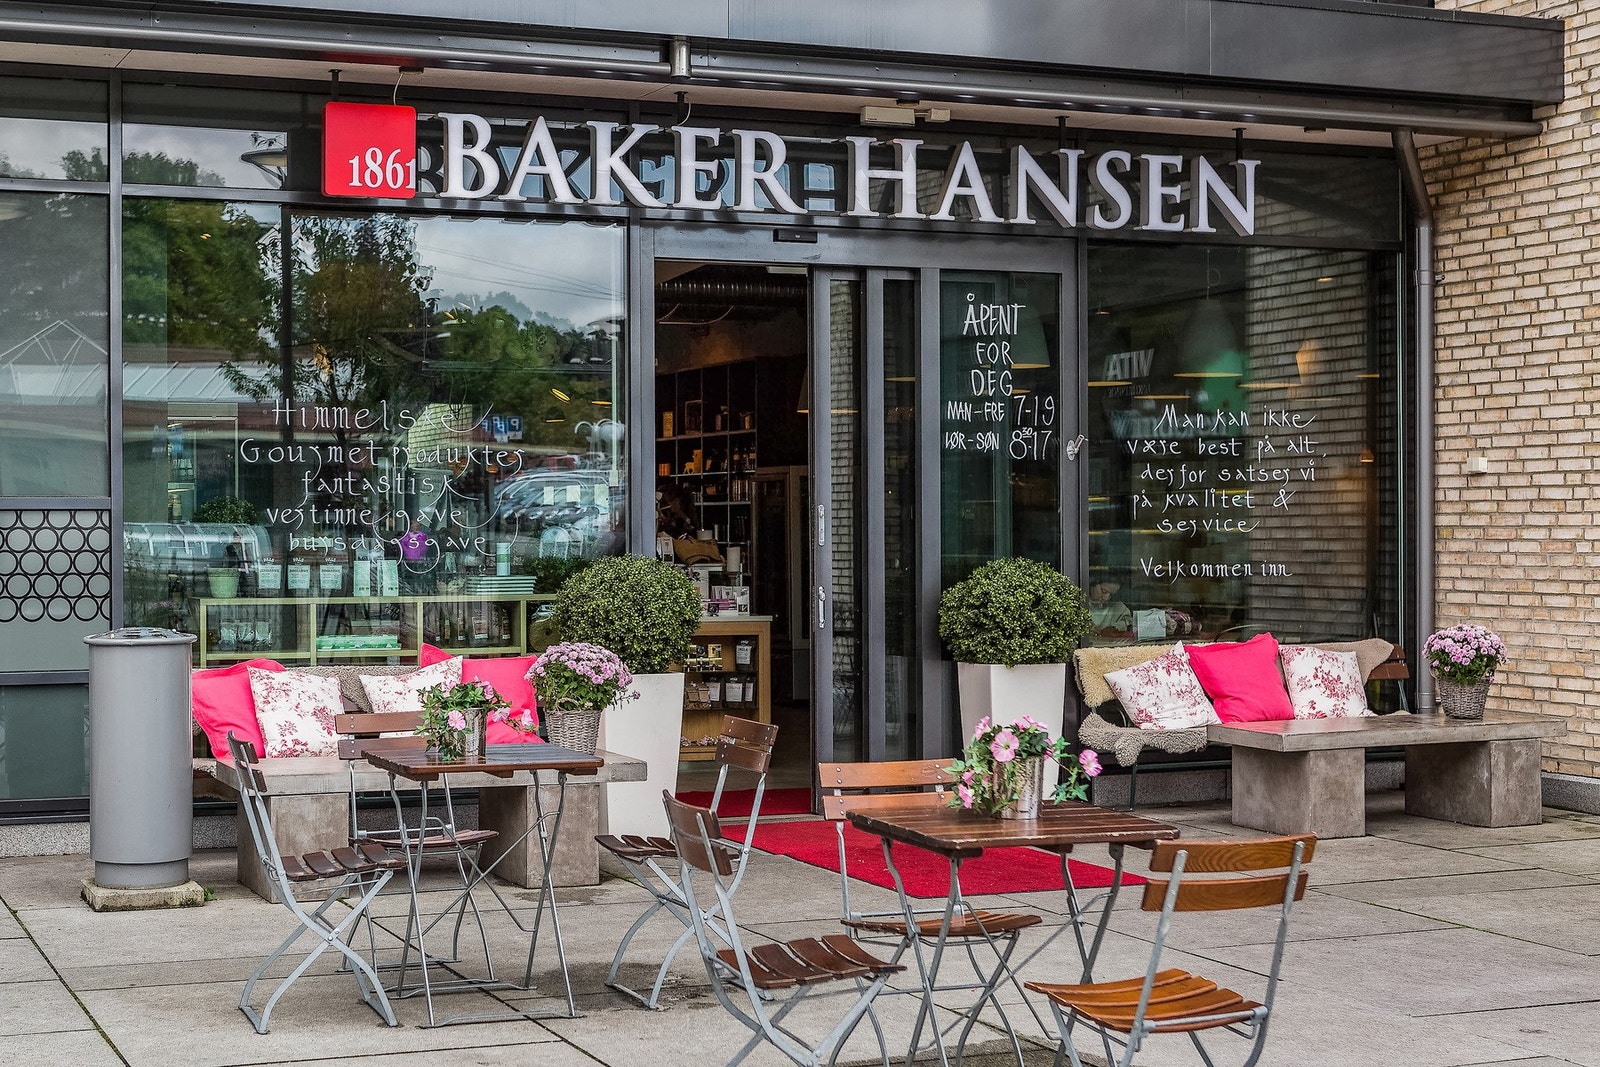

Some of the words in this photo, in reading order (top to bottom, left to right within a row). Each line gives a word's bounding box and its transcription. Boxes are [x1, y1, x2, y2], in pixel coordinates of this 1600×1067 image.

[348, 146, 416, 189] 1861
[437, 111, 808, 213] BAKER
[840, 135, 1262, 236] HANSEN
[962, 293, 1026, 336] ÅPENT
[976, 341, 1014, 365] FOR
[971, 369, 1014, 397] DEG
[271, 399, 494, 433] Himmelske
[1154, 404, 1205, 431] Man
[1211, 409, 1250, 432] kan
[1263, 405, 1317, 428] ikke
[1127, 439, 1182, 455] være
[1198, 438, 1243, 455] best
[1257, 436, 1276, 463] på
[1218, 465, 1291, 486] satser
[1300, 459, 1316, 482] vi
[298, 471, 479, 508] fantastisk
[1133, 490, 1153, 520] på
[1162, 488, 1257, 513] kvalitet
[1272, 488, 1297, 511] &
[390, 507, 468, 542] gave
[1140, 557, 1252, 585] Velkommen
[1262, 560, 1293, 577] inn
